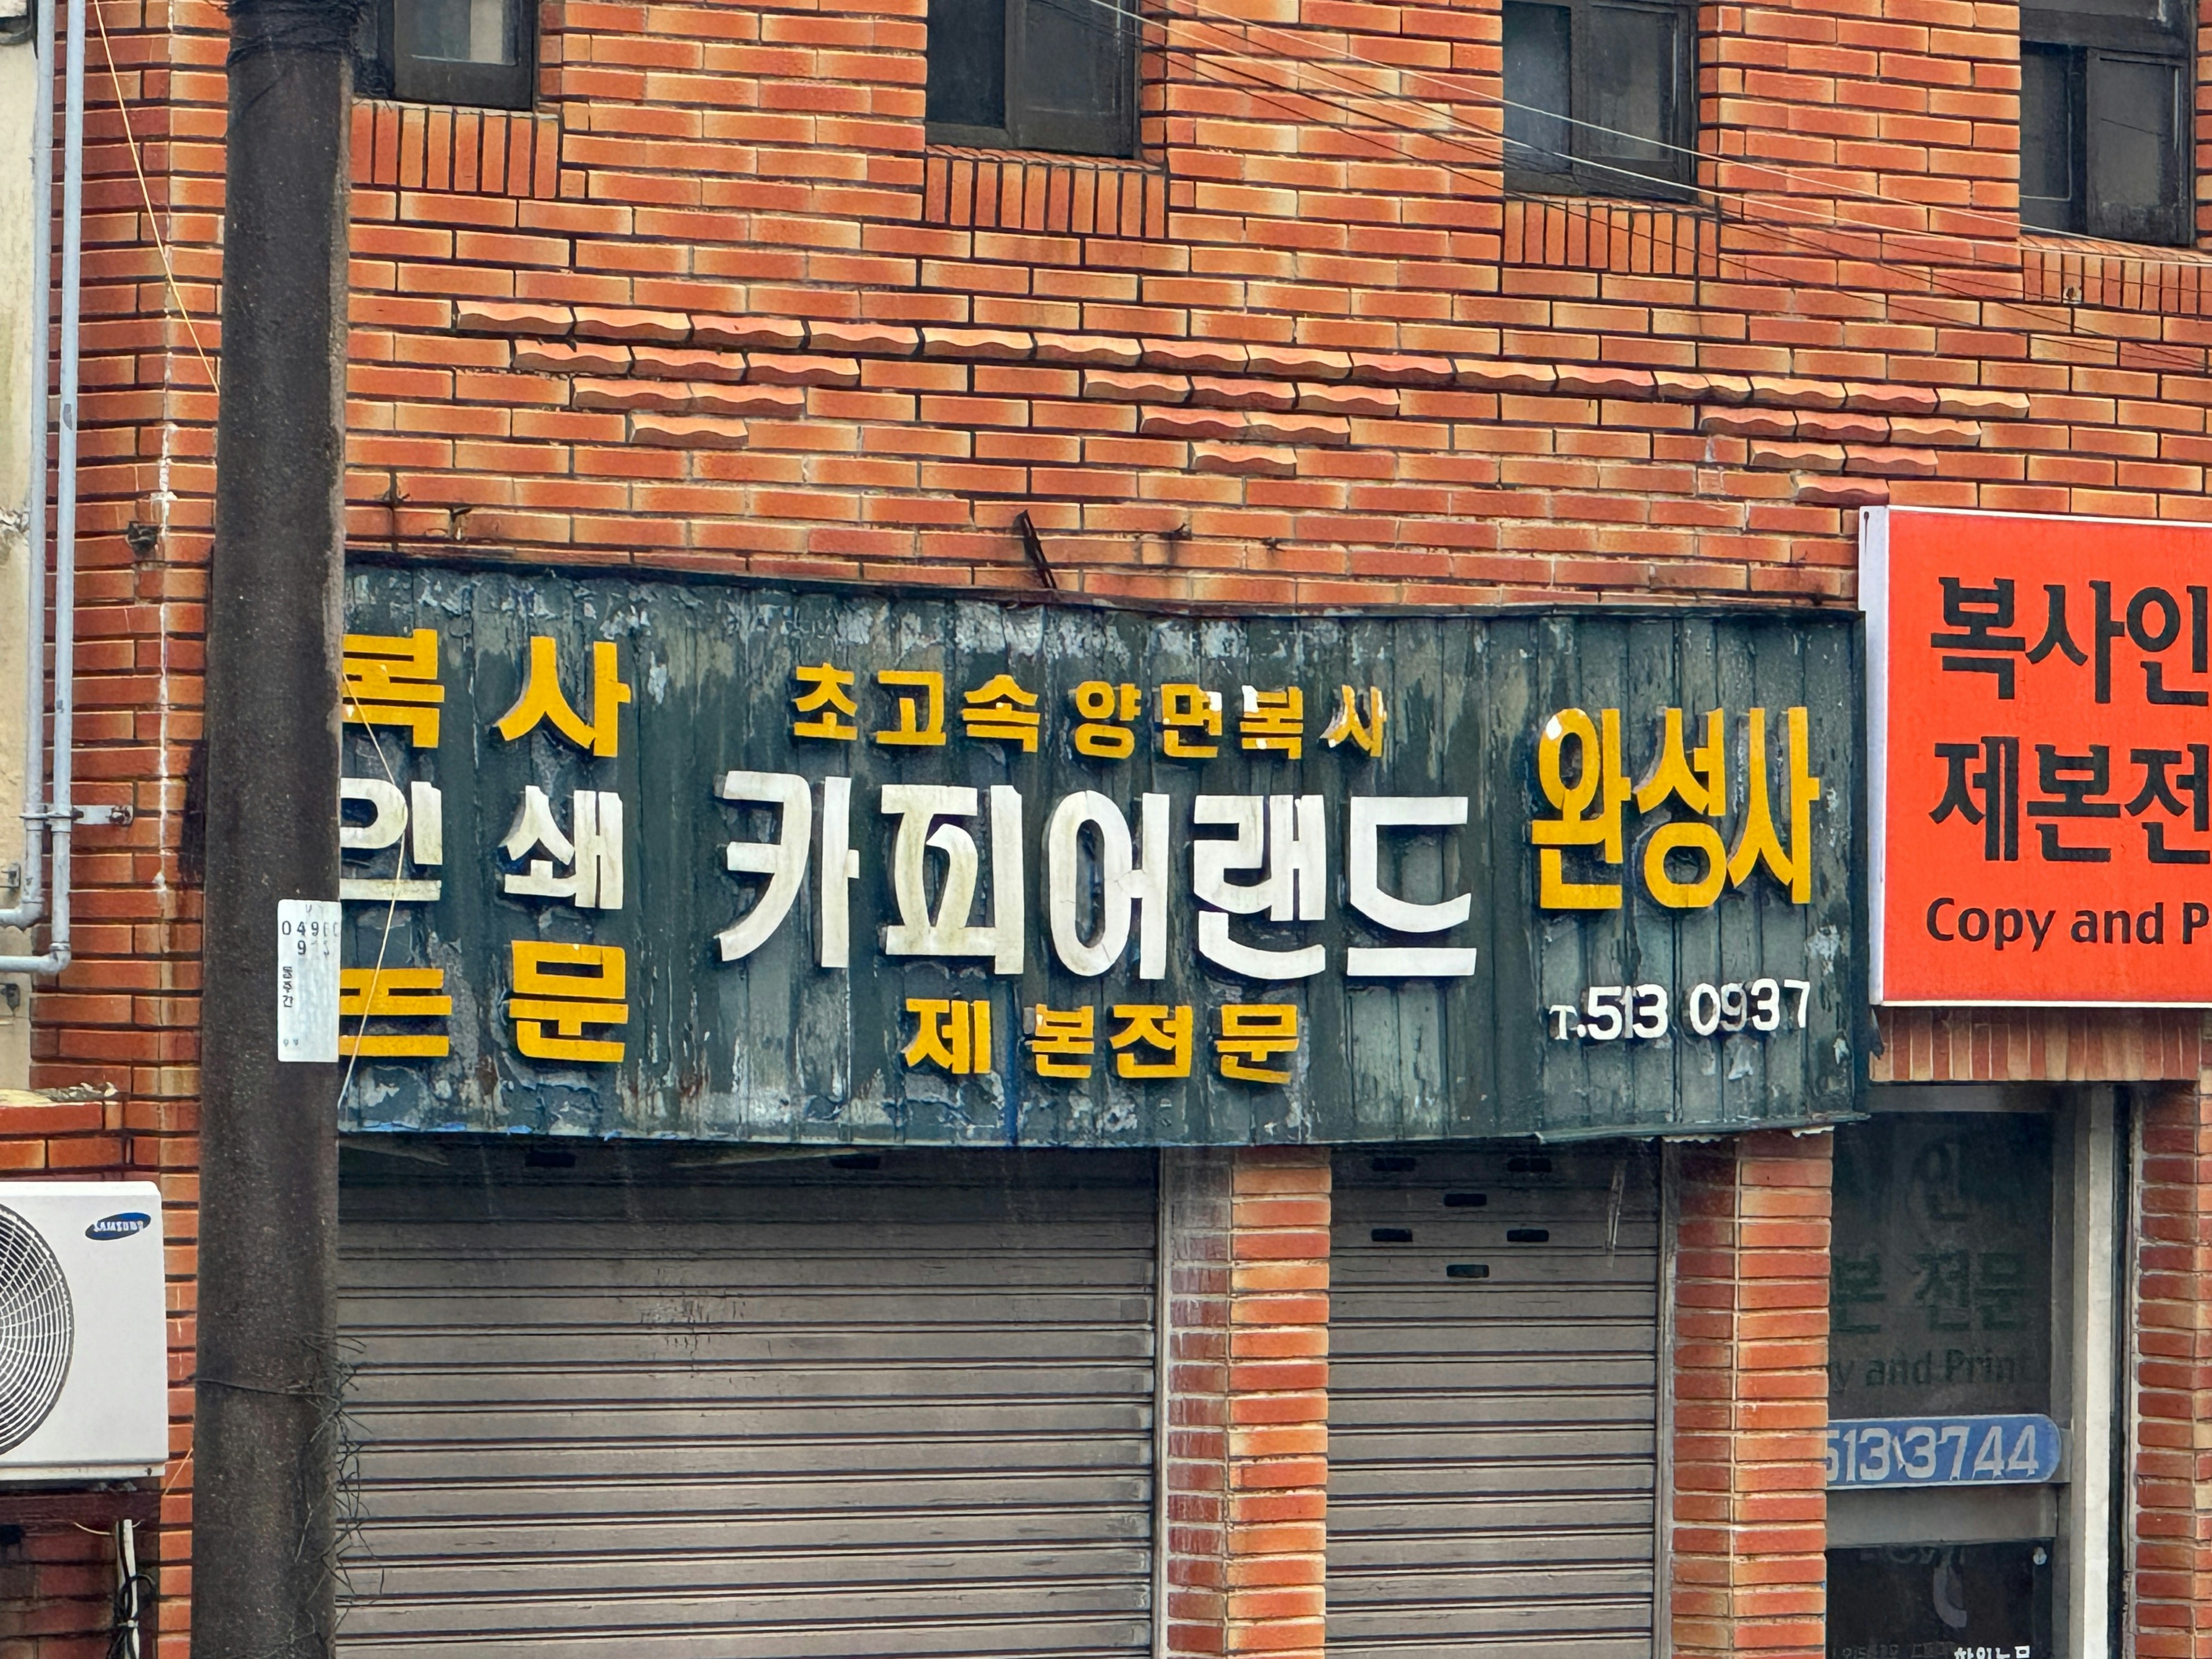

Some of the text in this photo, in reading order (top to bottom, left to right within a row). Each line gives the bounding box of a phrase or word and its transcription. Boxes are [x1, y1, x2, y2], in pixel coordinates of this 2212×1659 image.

[1930, 577, 2209, 707] 복사인
[793, 663, 1387, 759] 초고속 양면복사
[1532, 707, 1820, 909] 완성사
[1929, 736, 2210, 865] 제본전
[718, 770, 1477, 980] 카피어랜드
[1927, 898, 2054, 951] Copy
[2071, 902, 2163, 944] and
[1690, 978, 1810, 1036] 0937
[93, 1220, 144, 1232] SAMSUNG
